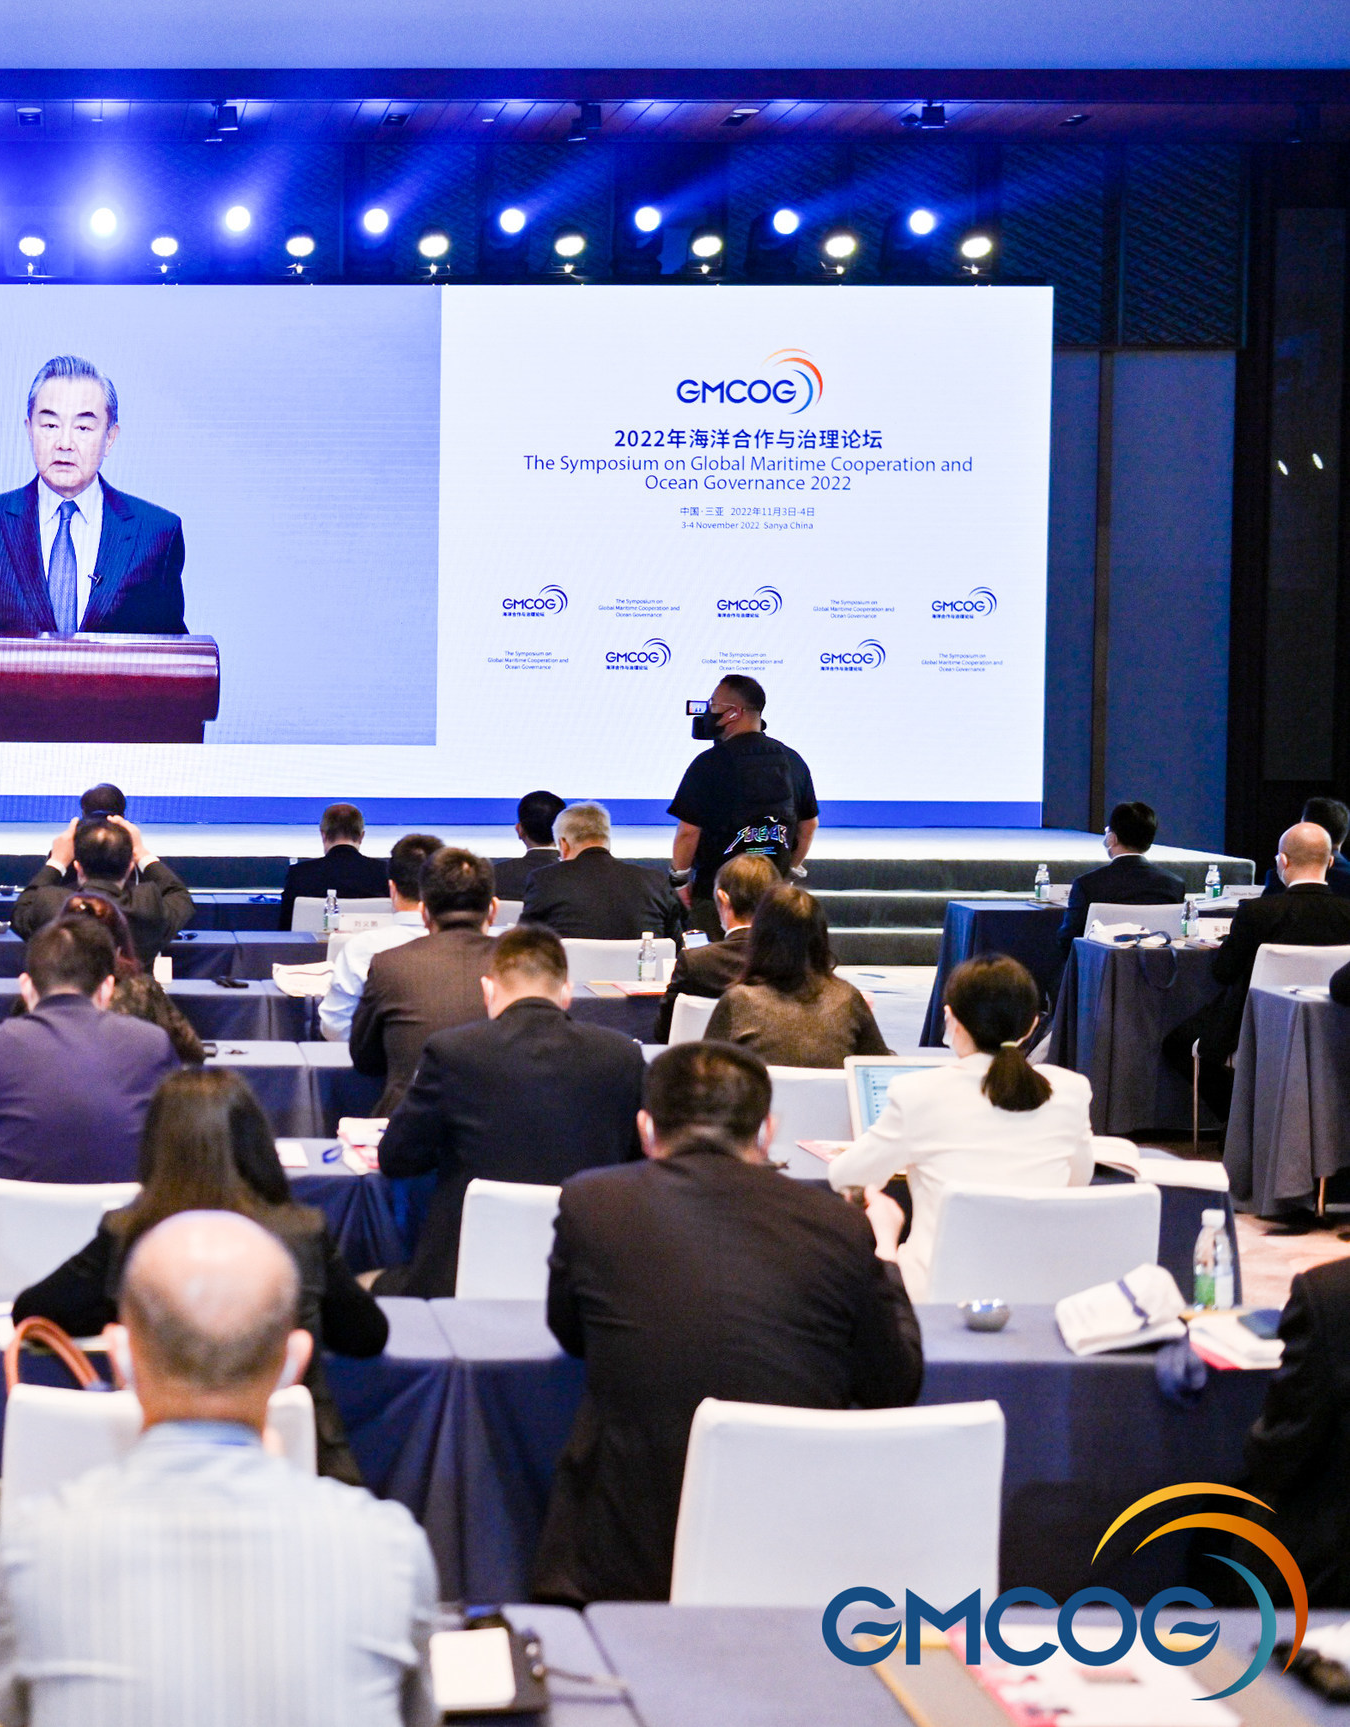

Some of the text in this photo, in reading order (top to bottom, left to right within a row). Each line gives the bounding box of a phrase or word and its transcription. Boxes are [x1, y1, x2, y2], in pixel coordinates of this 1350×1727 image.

[676, 380, 796, 404] GMCOG
[614, 428, 882, 449] 2022年海洋合作与治理论坛
[524, 455, 973, 475] The Symposium on Global Maritime Cooperation and
[645, 475, 851, 490] Ocean Governance 2022
[730, 507, 815, 516] 2022年11月3日-4日
[764, 522, 788, 531] Sanya
[502, 598, 556, 610] GMCOG
[717, 599, 770, 610] GMCOG
[932, 600, 985, 612] GMCOG
[606, 652, 659, 663] GMCOG
[820, 653, 874, 664] GMCOG
